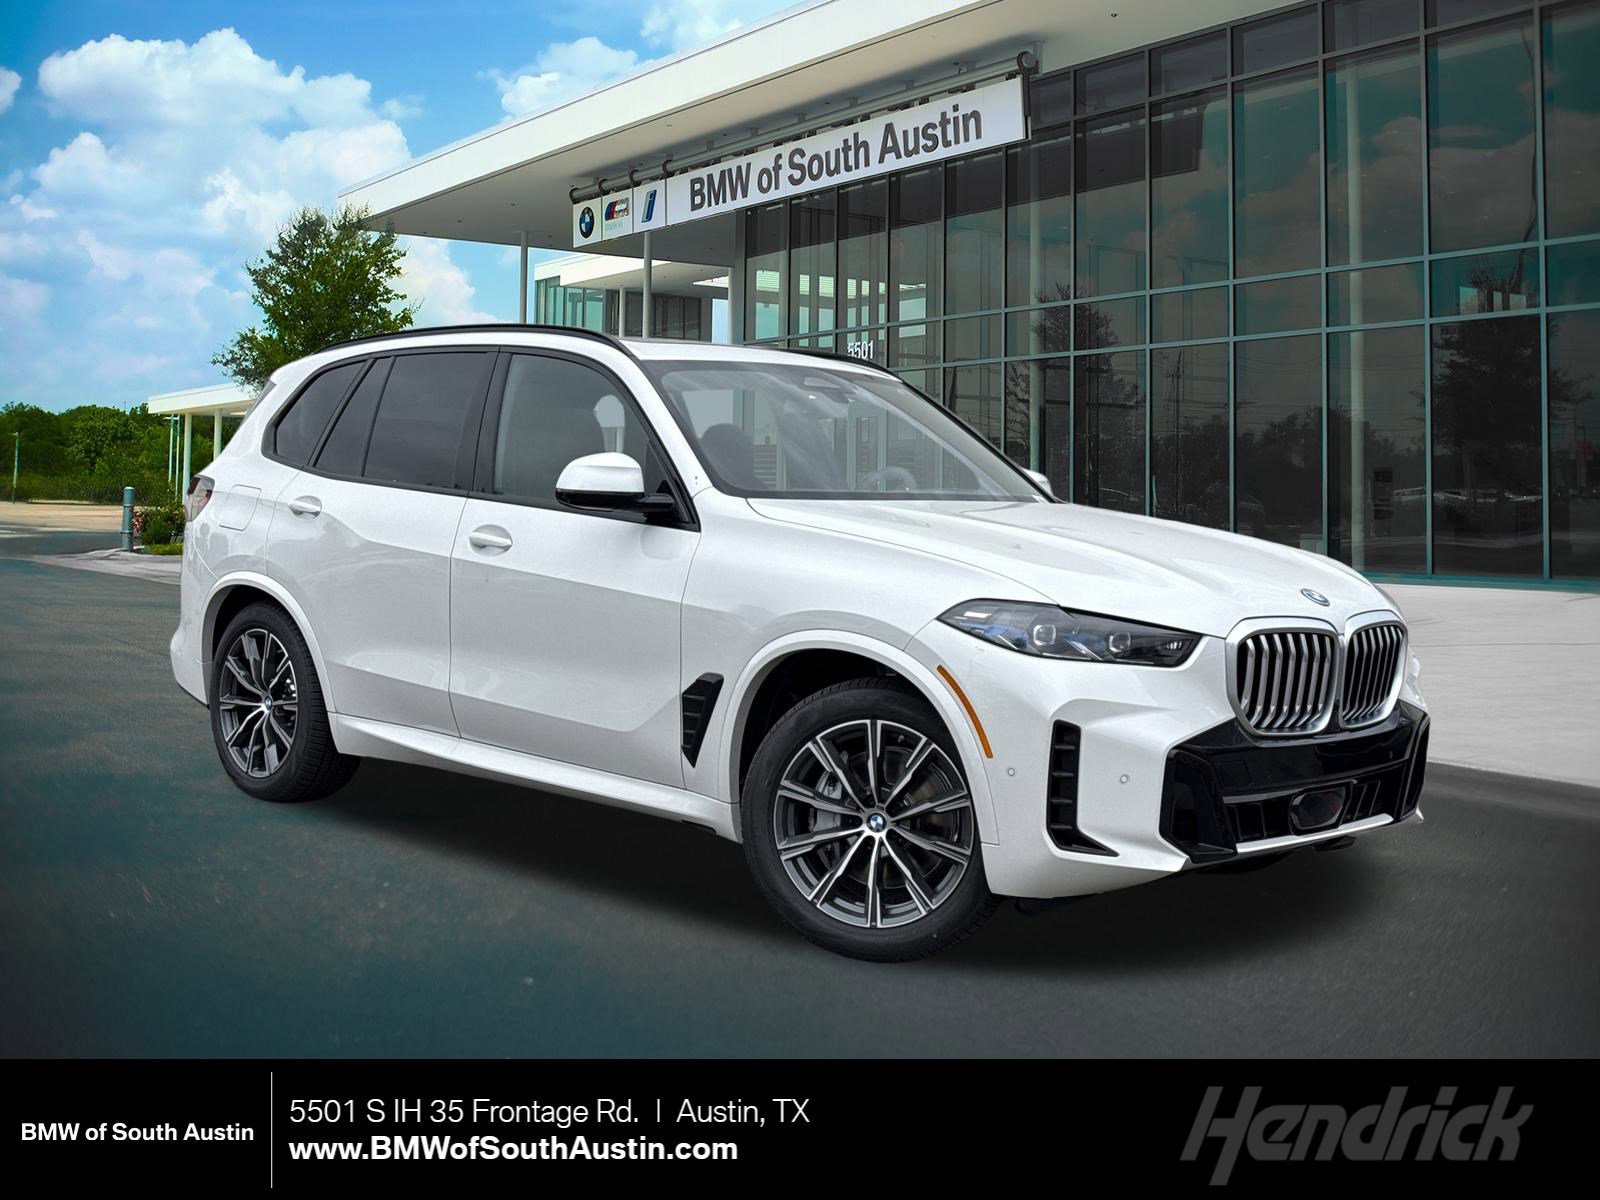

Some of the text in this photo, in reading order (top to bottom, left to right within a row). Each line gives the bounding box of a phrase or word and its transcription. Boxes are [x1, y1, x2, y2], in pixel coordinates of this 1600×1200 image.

[690, 162, 751, 212] BMW
[757, 153, 783, 194] of
[787, 132, 870, 187] South
[877, 103, 983, 165] Austin
[847, 340, 874, 360] 5501
